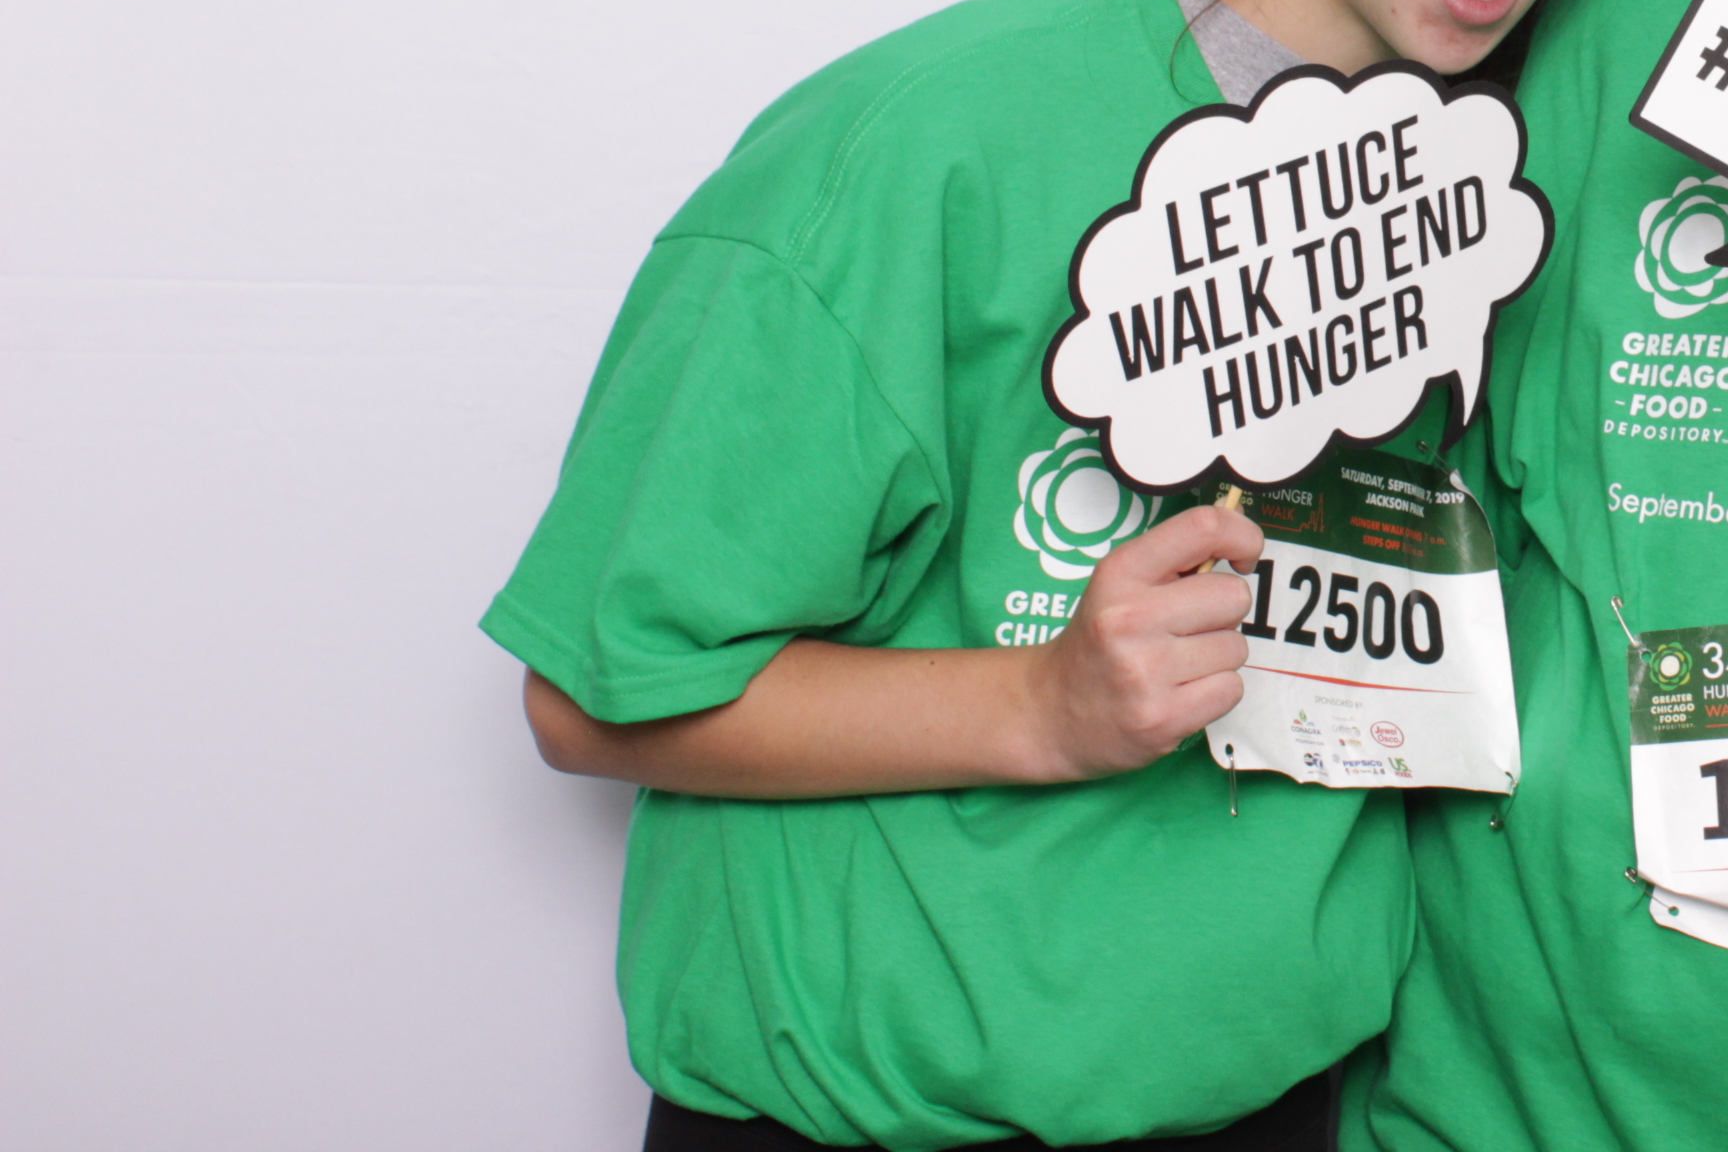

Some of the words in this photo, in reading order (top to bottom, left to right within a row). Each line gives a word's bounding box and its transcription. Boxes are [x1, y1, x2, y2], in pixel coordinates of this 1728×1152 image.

[1165, 114, 1424, 275] LETTUCE
[1108, 256, 1284, 382] WALK
[1292, 227, 1365, 314] TO
[1380, 175, 1487, 281] END
[1202, 284, 1429, 438] HUNGER
[1341, 467, 1386, 491] SATURDAY,
[1435, 490, 1466, 504] 2019
[1261, 502, 1295, 521] WALK
[1365, 492, 1410, 513] JACKSON
[1350, 516, 1381, 532] HUNGER
[1384, 538, 1401, 551] OFF
[1241, 558, 1445, 665] 12500
[1651, 703, 1695, 715] CHICAGO
[1652, 693, 1693, 705] GREATER
[1343, 759, 1383, 768] PEPSICO
